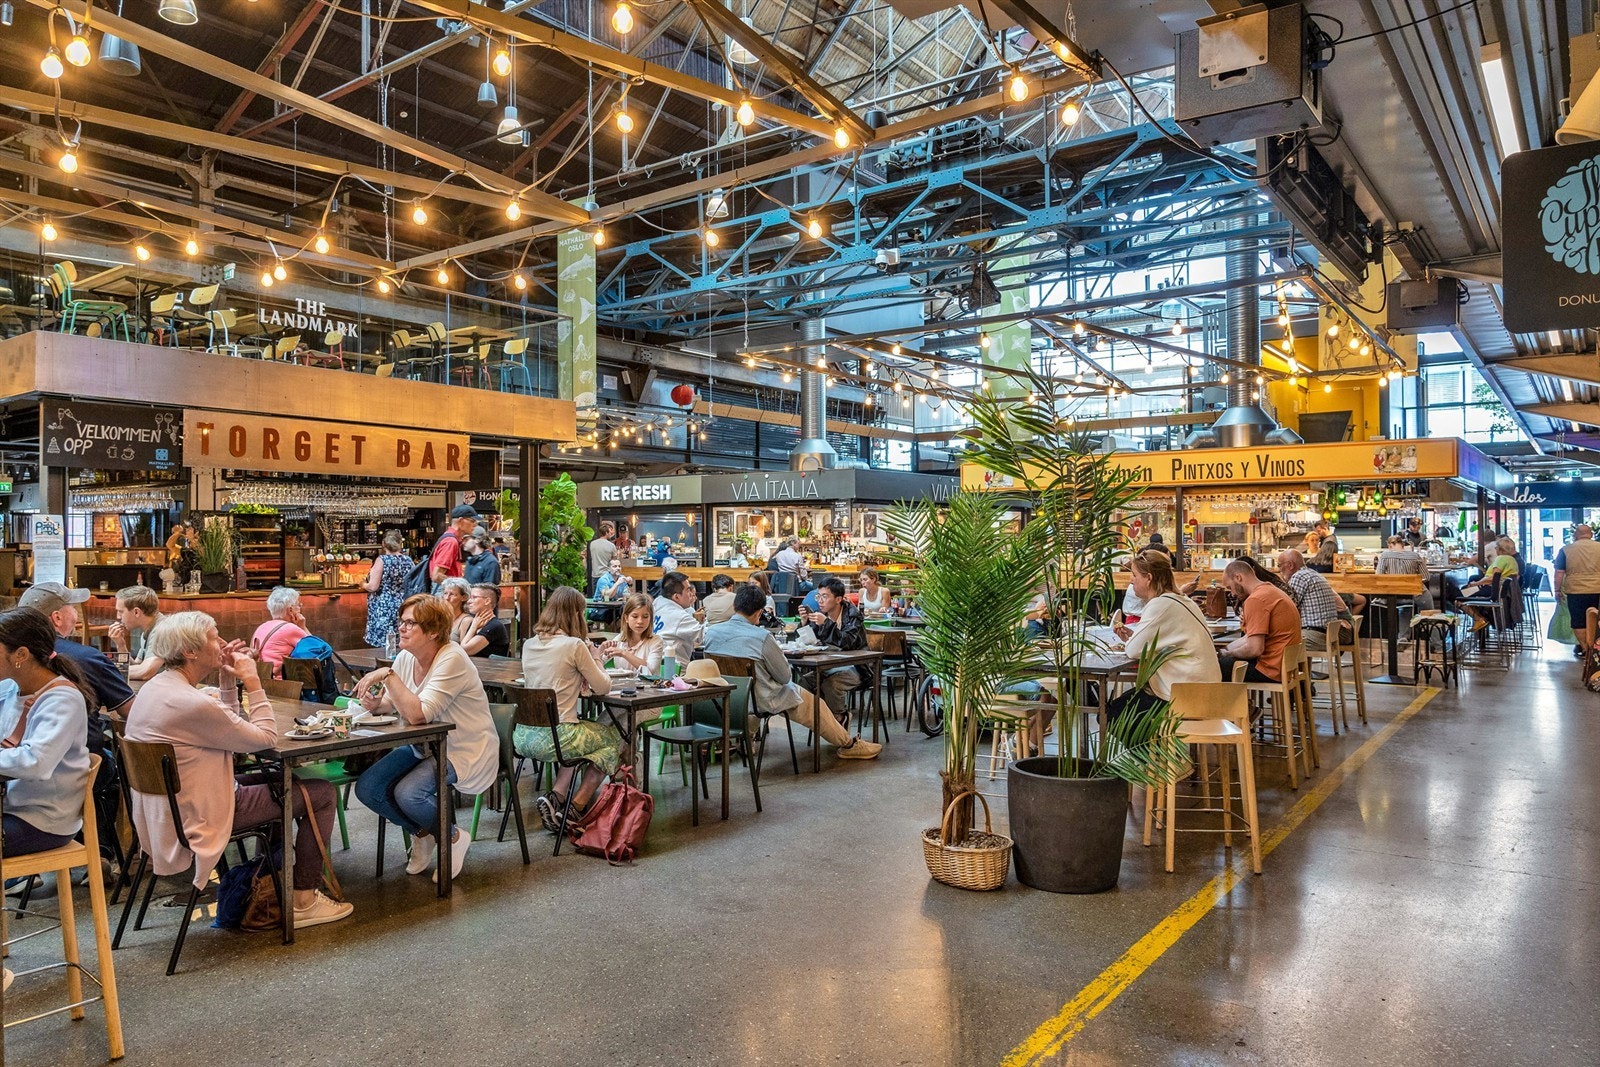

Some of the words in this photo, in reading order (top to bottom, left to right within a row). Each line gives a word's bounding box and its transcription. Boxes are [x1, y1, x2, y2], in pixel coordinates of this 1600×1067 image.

[568, 243, 583, 252] OSLO
[295, 298, 327, 317] THE
[260, 308, 359, 338] LANDMARK
[76, 424, 161, 443] VELKOMMEN
[64, 437, 93, 455] OPP
[197, 421, 366, 465] TORGET
[397, 438, 460, 471] BAR
[1171, 458, 1233, 480] PINTXOS
[1256, 454, 1305, 478] VINOS
[601, 485, 672, 501] REFRESH
[731, 480, 761, 501] VIA
[765, 478, 819, 499] ITALIA
[931, 483, 949, 501] VIA
[1512, 486, 1546, 503] ldos
